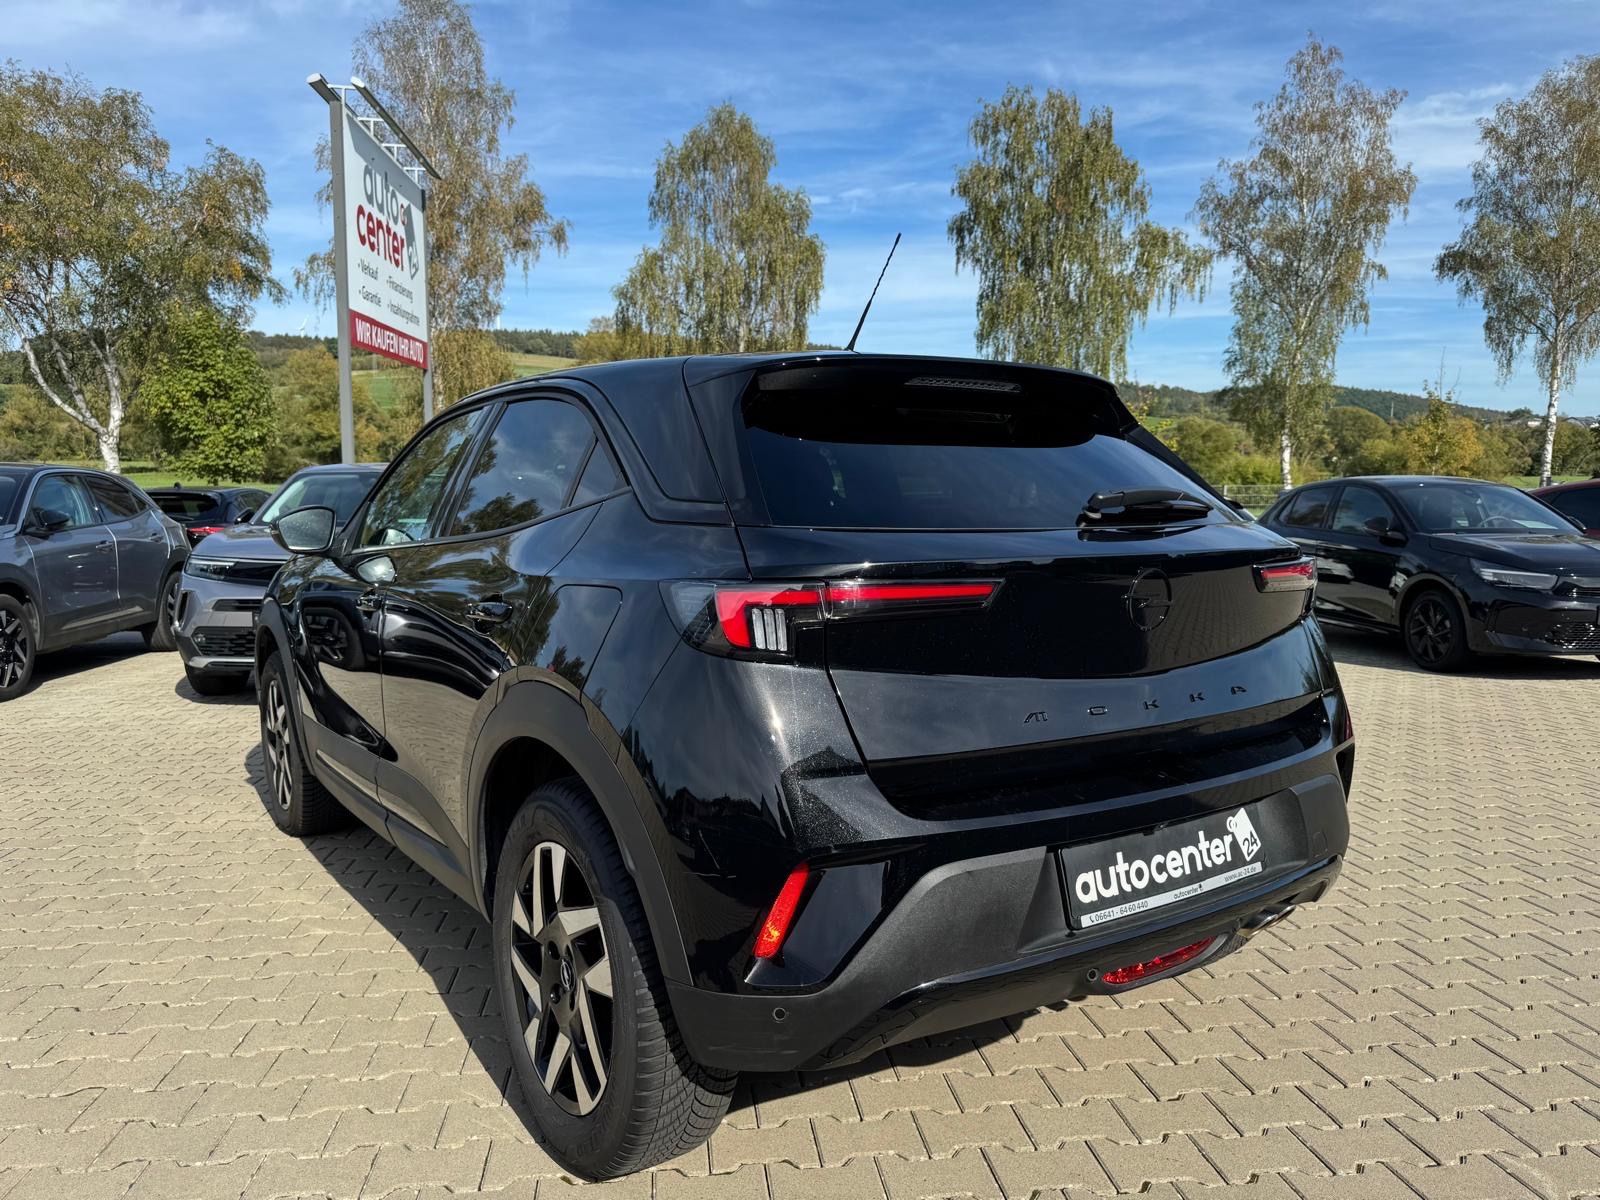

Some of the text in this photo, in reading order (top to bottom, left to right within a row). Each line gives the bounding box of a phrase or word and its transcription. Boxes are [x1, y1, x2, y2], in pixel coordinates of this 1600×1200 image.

[363, 164, 399, 226] auto
[357, 204, 405, 272] center
[360, 258, 379, 281] Verkauf
[361, 285, 382, 307] Garantie
[355, 318, 424, 364] WIR KAUFEN IHR AUTO
[1242, 830, 1259, 858] 24
[1075, 830, 1233, 904] autocenter
[1173, 886, 1199, 899] autocenter
[1095, 909, 1115, 921] 06641
